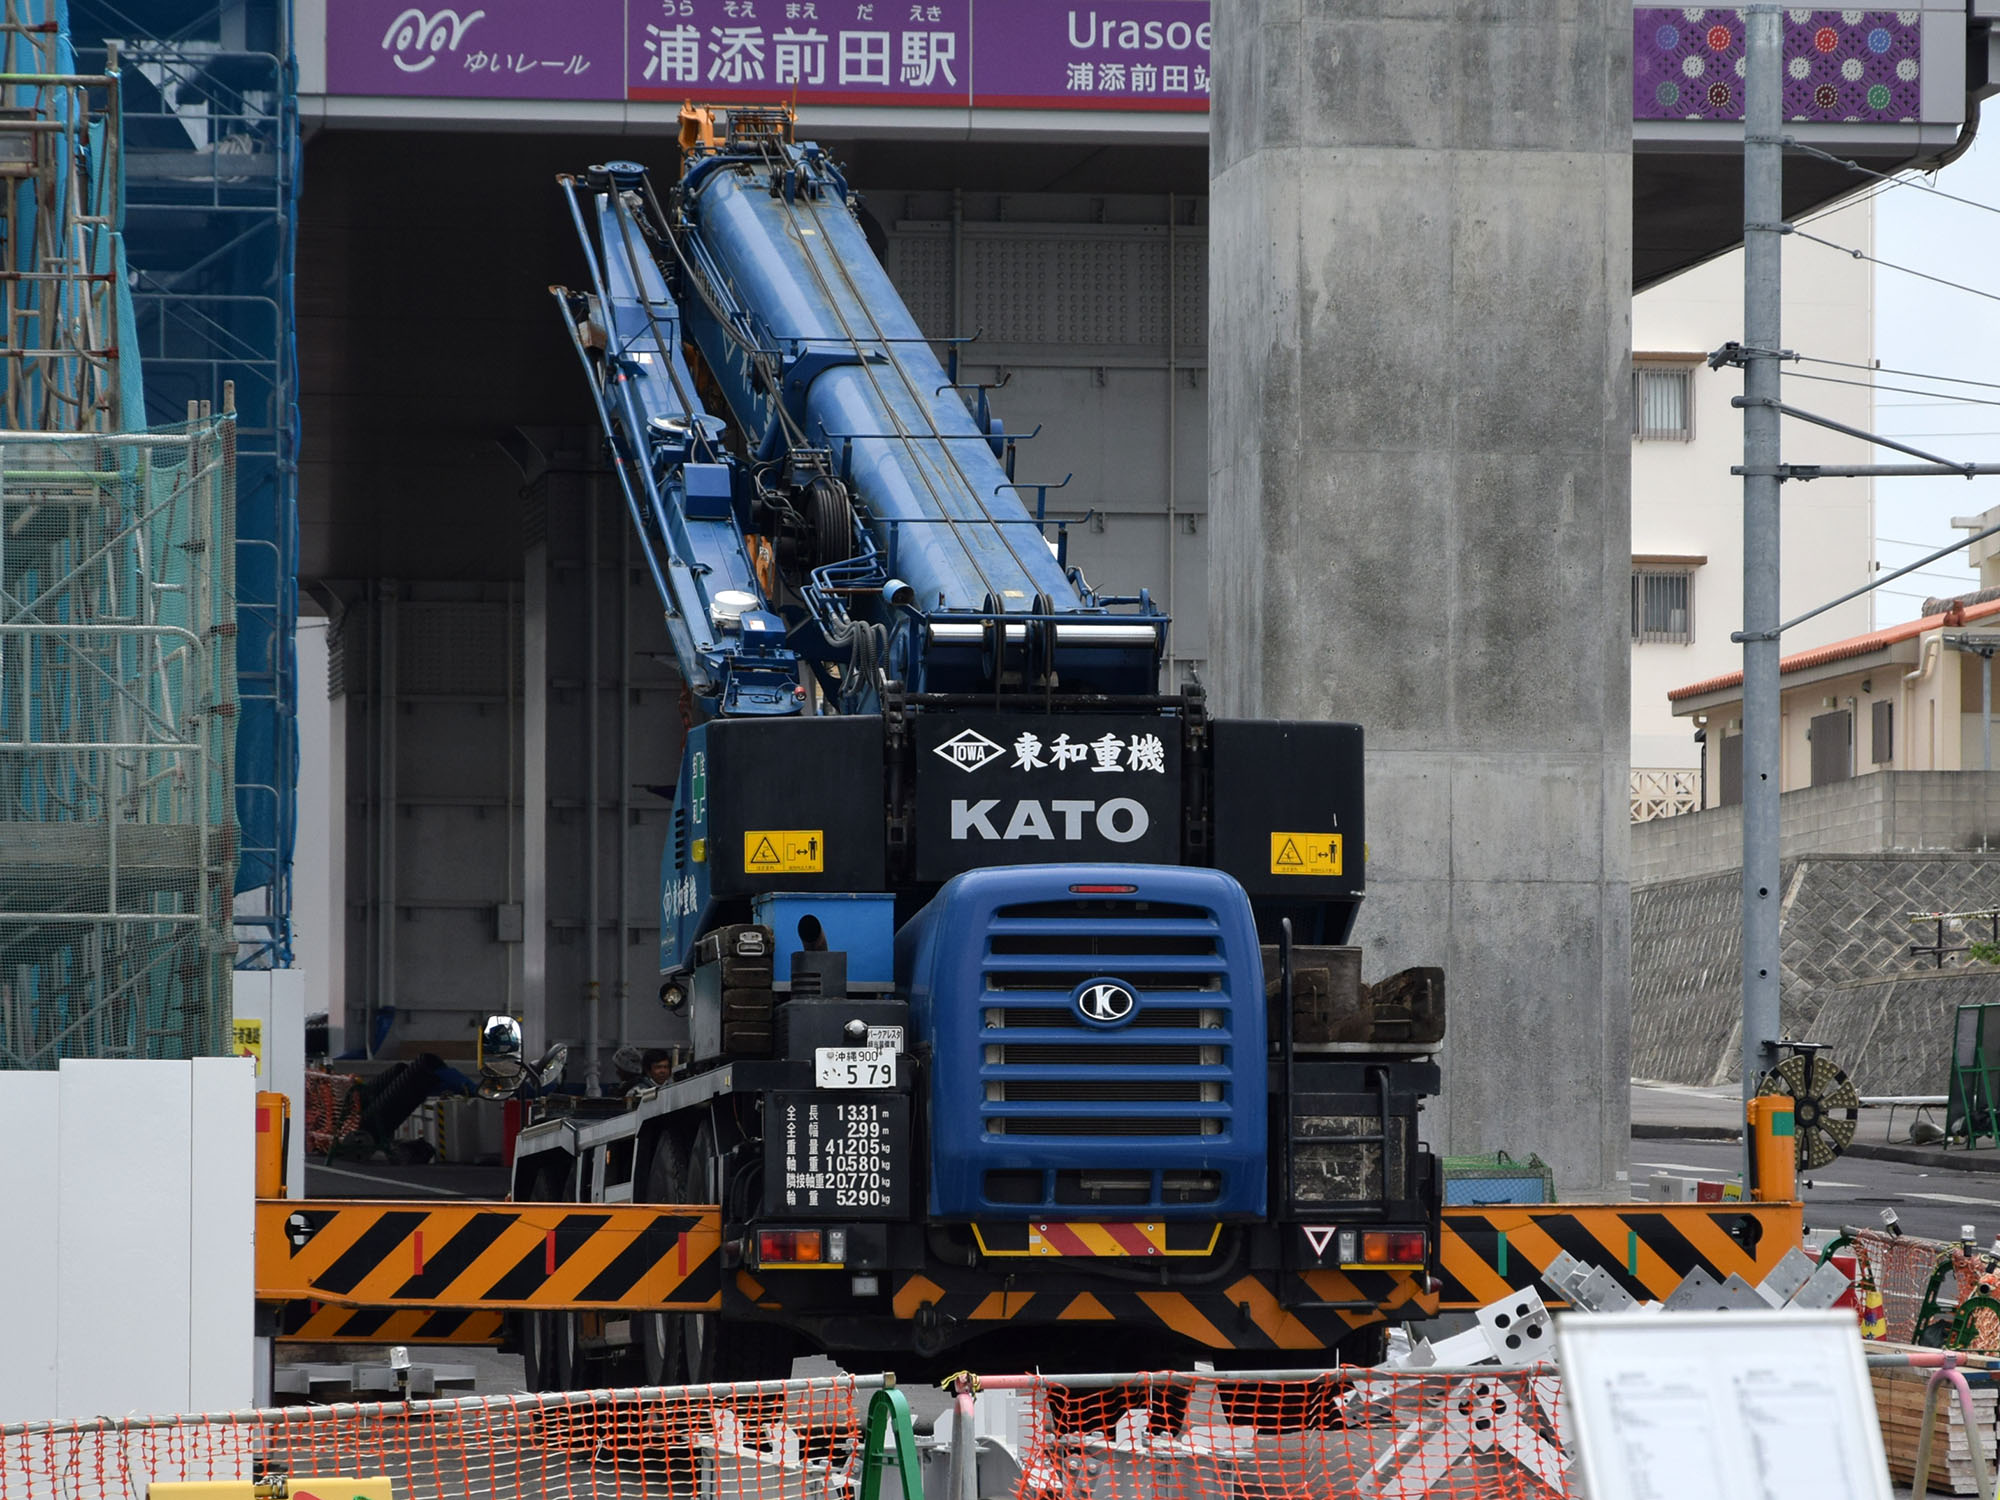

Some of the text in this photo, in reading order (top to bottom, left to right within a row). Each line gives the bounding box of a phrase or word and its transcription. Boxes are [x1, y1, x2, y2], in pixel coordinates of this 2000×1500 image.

[1068, 10, 1210, 51] Urasoe
[642, 22, 957, 87] 浦添前田駅
[463, 51, 591, 75] ゆいレール
[1010, 731, 1165, 774] 東和重機
[951, 797, 1150, 843] KATO
[822, 1069, 830, 1081] さ
[882, 1110, 890, 1118] m
[882, 1127, 890, 1135] m
[881, 1143, 891, 1154] kg
[881, 1160, 891, 1171] kg
[881, 1177, 891, 1188] kg
[881, 1194, 891, 1205] kg
